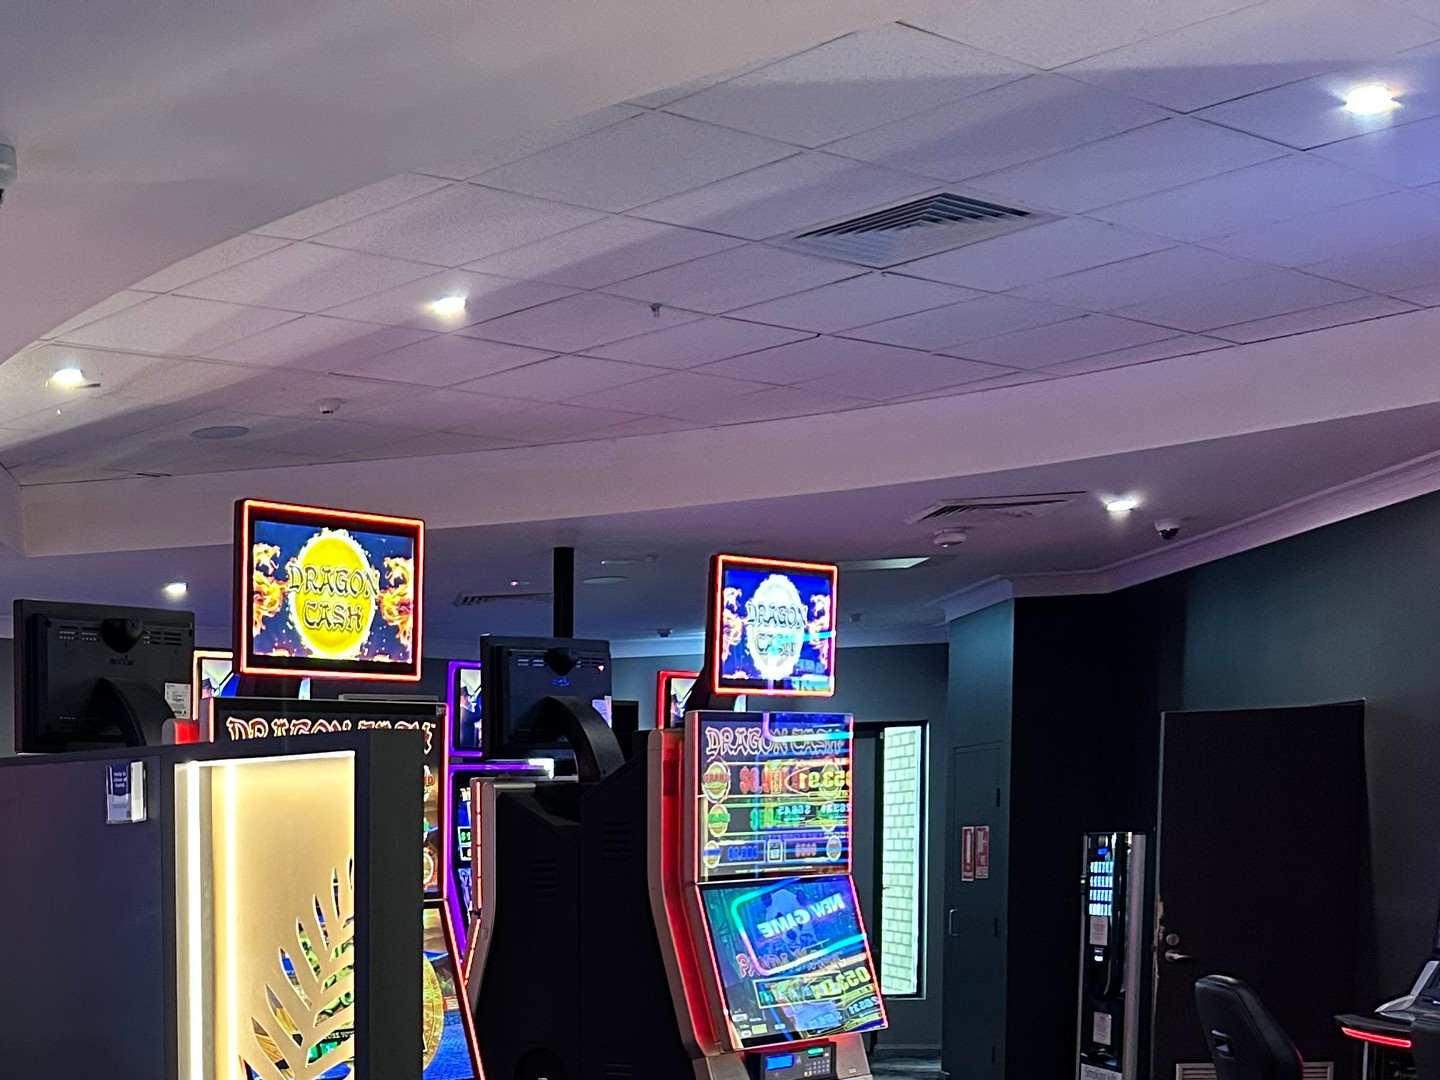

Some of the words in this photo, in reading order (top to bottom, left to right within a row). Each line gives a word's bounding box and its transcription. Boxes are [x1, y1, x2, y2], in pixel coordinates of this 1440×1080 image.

[288, 564, 381, 599] DRAGON
[303, 600, 364, 632] CASH
[746, 602, 809, 629] DRAGON
